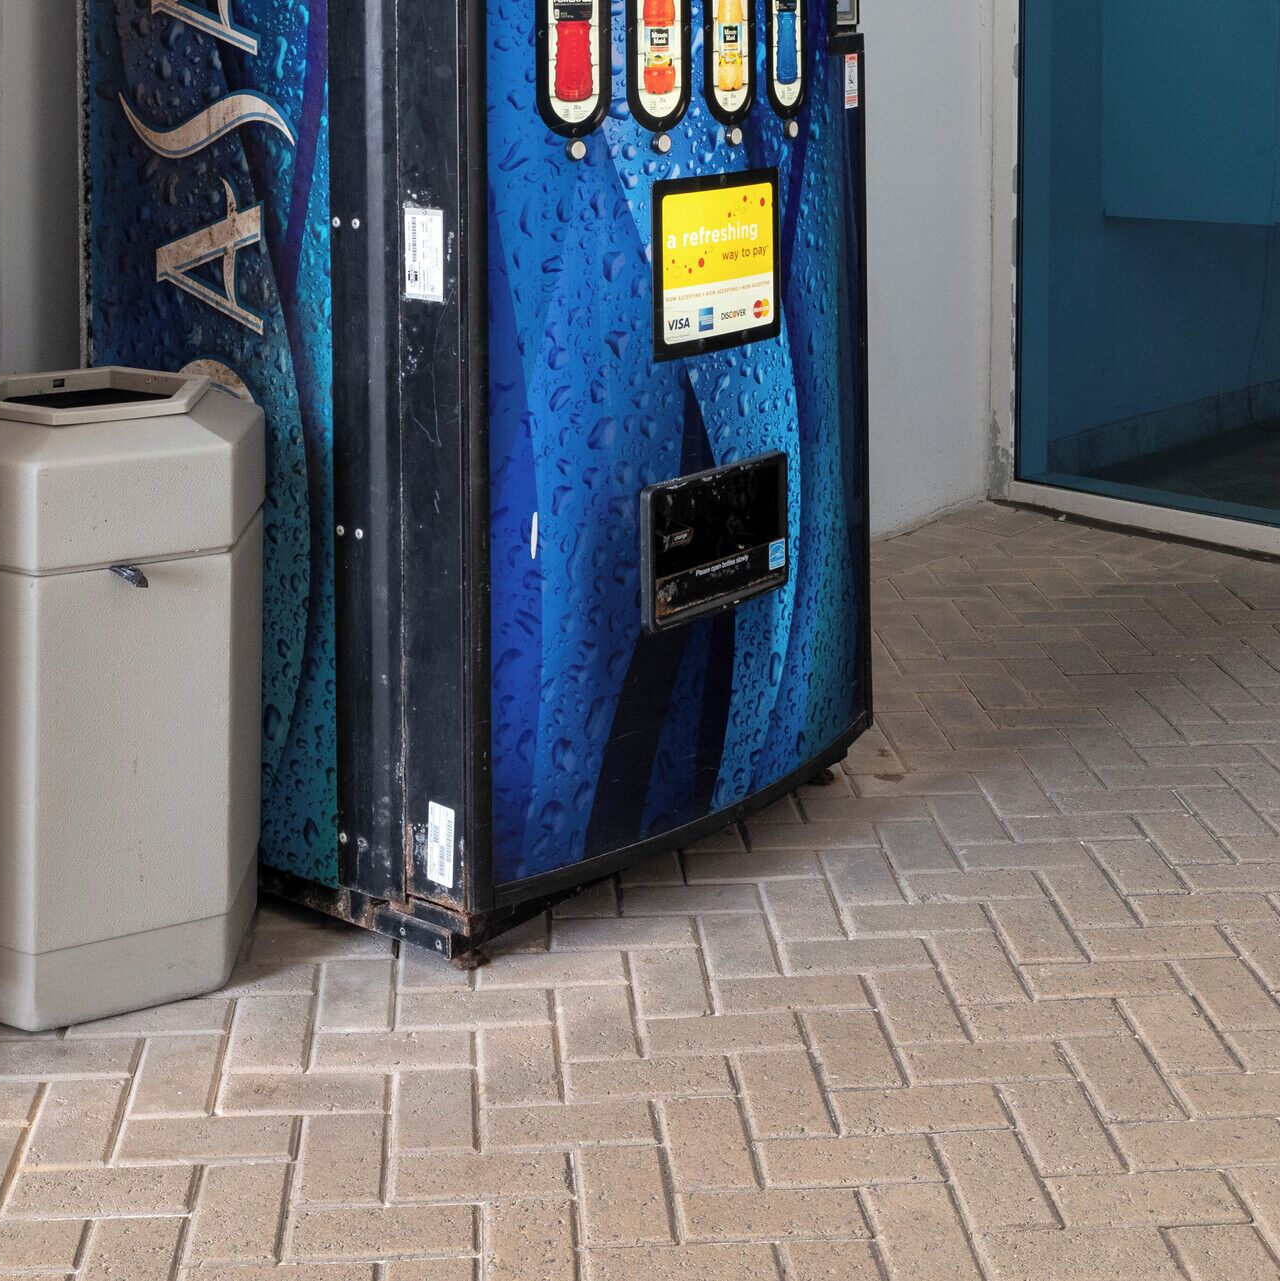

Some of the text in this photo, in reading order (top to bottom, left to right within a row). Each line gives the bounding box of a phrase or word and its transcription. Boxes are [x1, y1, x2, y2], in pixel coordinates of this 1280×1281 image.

[666, 222, 758, 249] a refreshing
[722, 245, 767, 261] way to pay
[668, 317, 690, 331] VISA
[720, 309, 747, 321] DISCOVER
[673, 533, 688, 541] change
[695, 554, 749, 577] Please open bottles slowly
